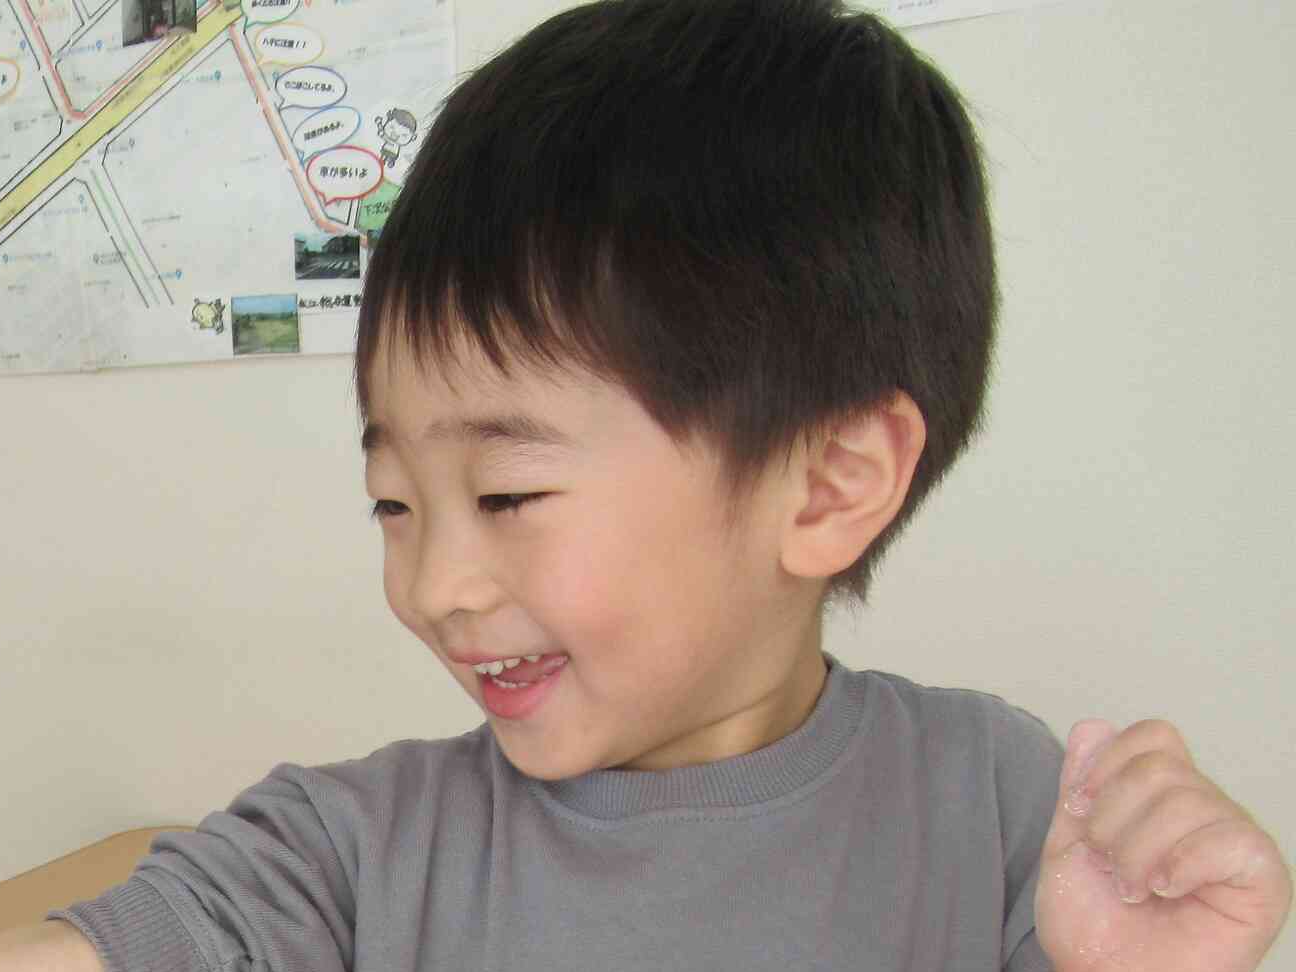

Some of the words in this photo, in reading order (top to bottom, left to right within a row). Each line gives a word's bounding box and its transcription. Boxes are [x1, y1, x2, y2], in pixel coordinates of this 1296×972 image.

[319, 166, 369, 179] 車が多いよ
